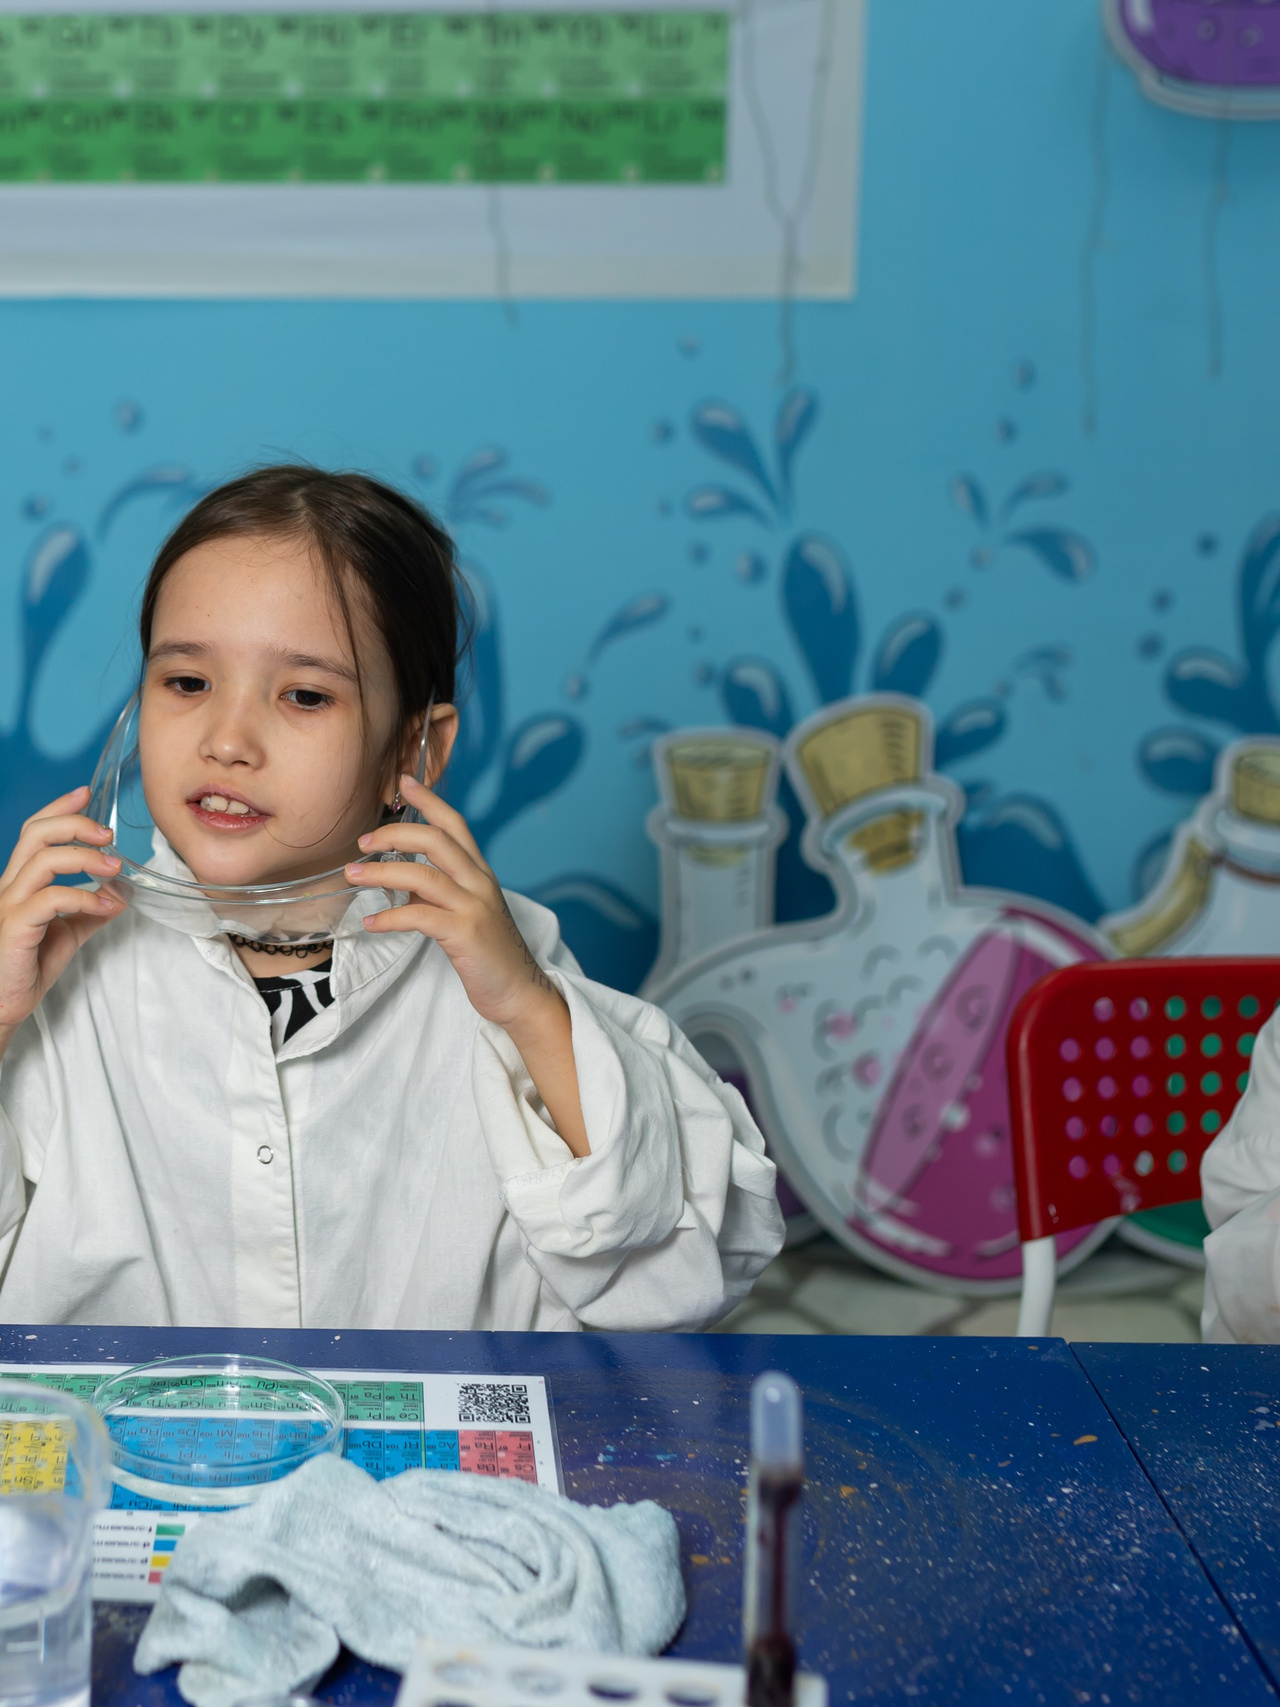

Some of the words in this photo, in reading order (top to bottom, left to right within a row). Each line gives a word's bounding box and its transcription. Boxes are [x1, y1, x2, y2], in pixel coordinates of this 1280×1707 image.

[179, 1379, 203, 1388] Cm
[256, 1380, 276, 1389] Pu
[79, 1385, 96, 1393] Es
[364, 1392, 382, 1400] Pa
[400, 1392, 418, 1401] Th
[147, 1400, 163, 1408] Tb
[180, 1400, 200, 1409] Gd
[250, 1402, 273, 1410] Sm
[366, 1412, 382, 1420] Pr
[399, 1412, 419, 1421] Ce
[139, 1426, 159, 1436] Rg
[177, 1428, 196, 1437] Ds
[216, 1429, 233, 1438] Mt
[252, 1430, 270, 1438] Hs
[362, 1440, 382, 1449] Db
[402, 1441, 419, 1450] Rf
[438, 1441, 457, 1450] Ac
[474, 1442, 494, 1451] Ra
[517, 1442, 531, 1451] Fr
[137, 1449, 156, 1458] Au
[249, 1451, 269, 1459] Os
[477, 1463, 496, 1472] Ba
[514, 1463, 534, 1472] Cs
